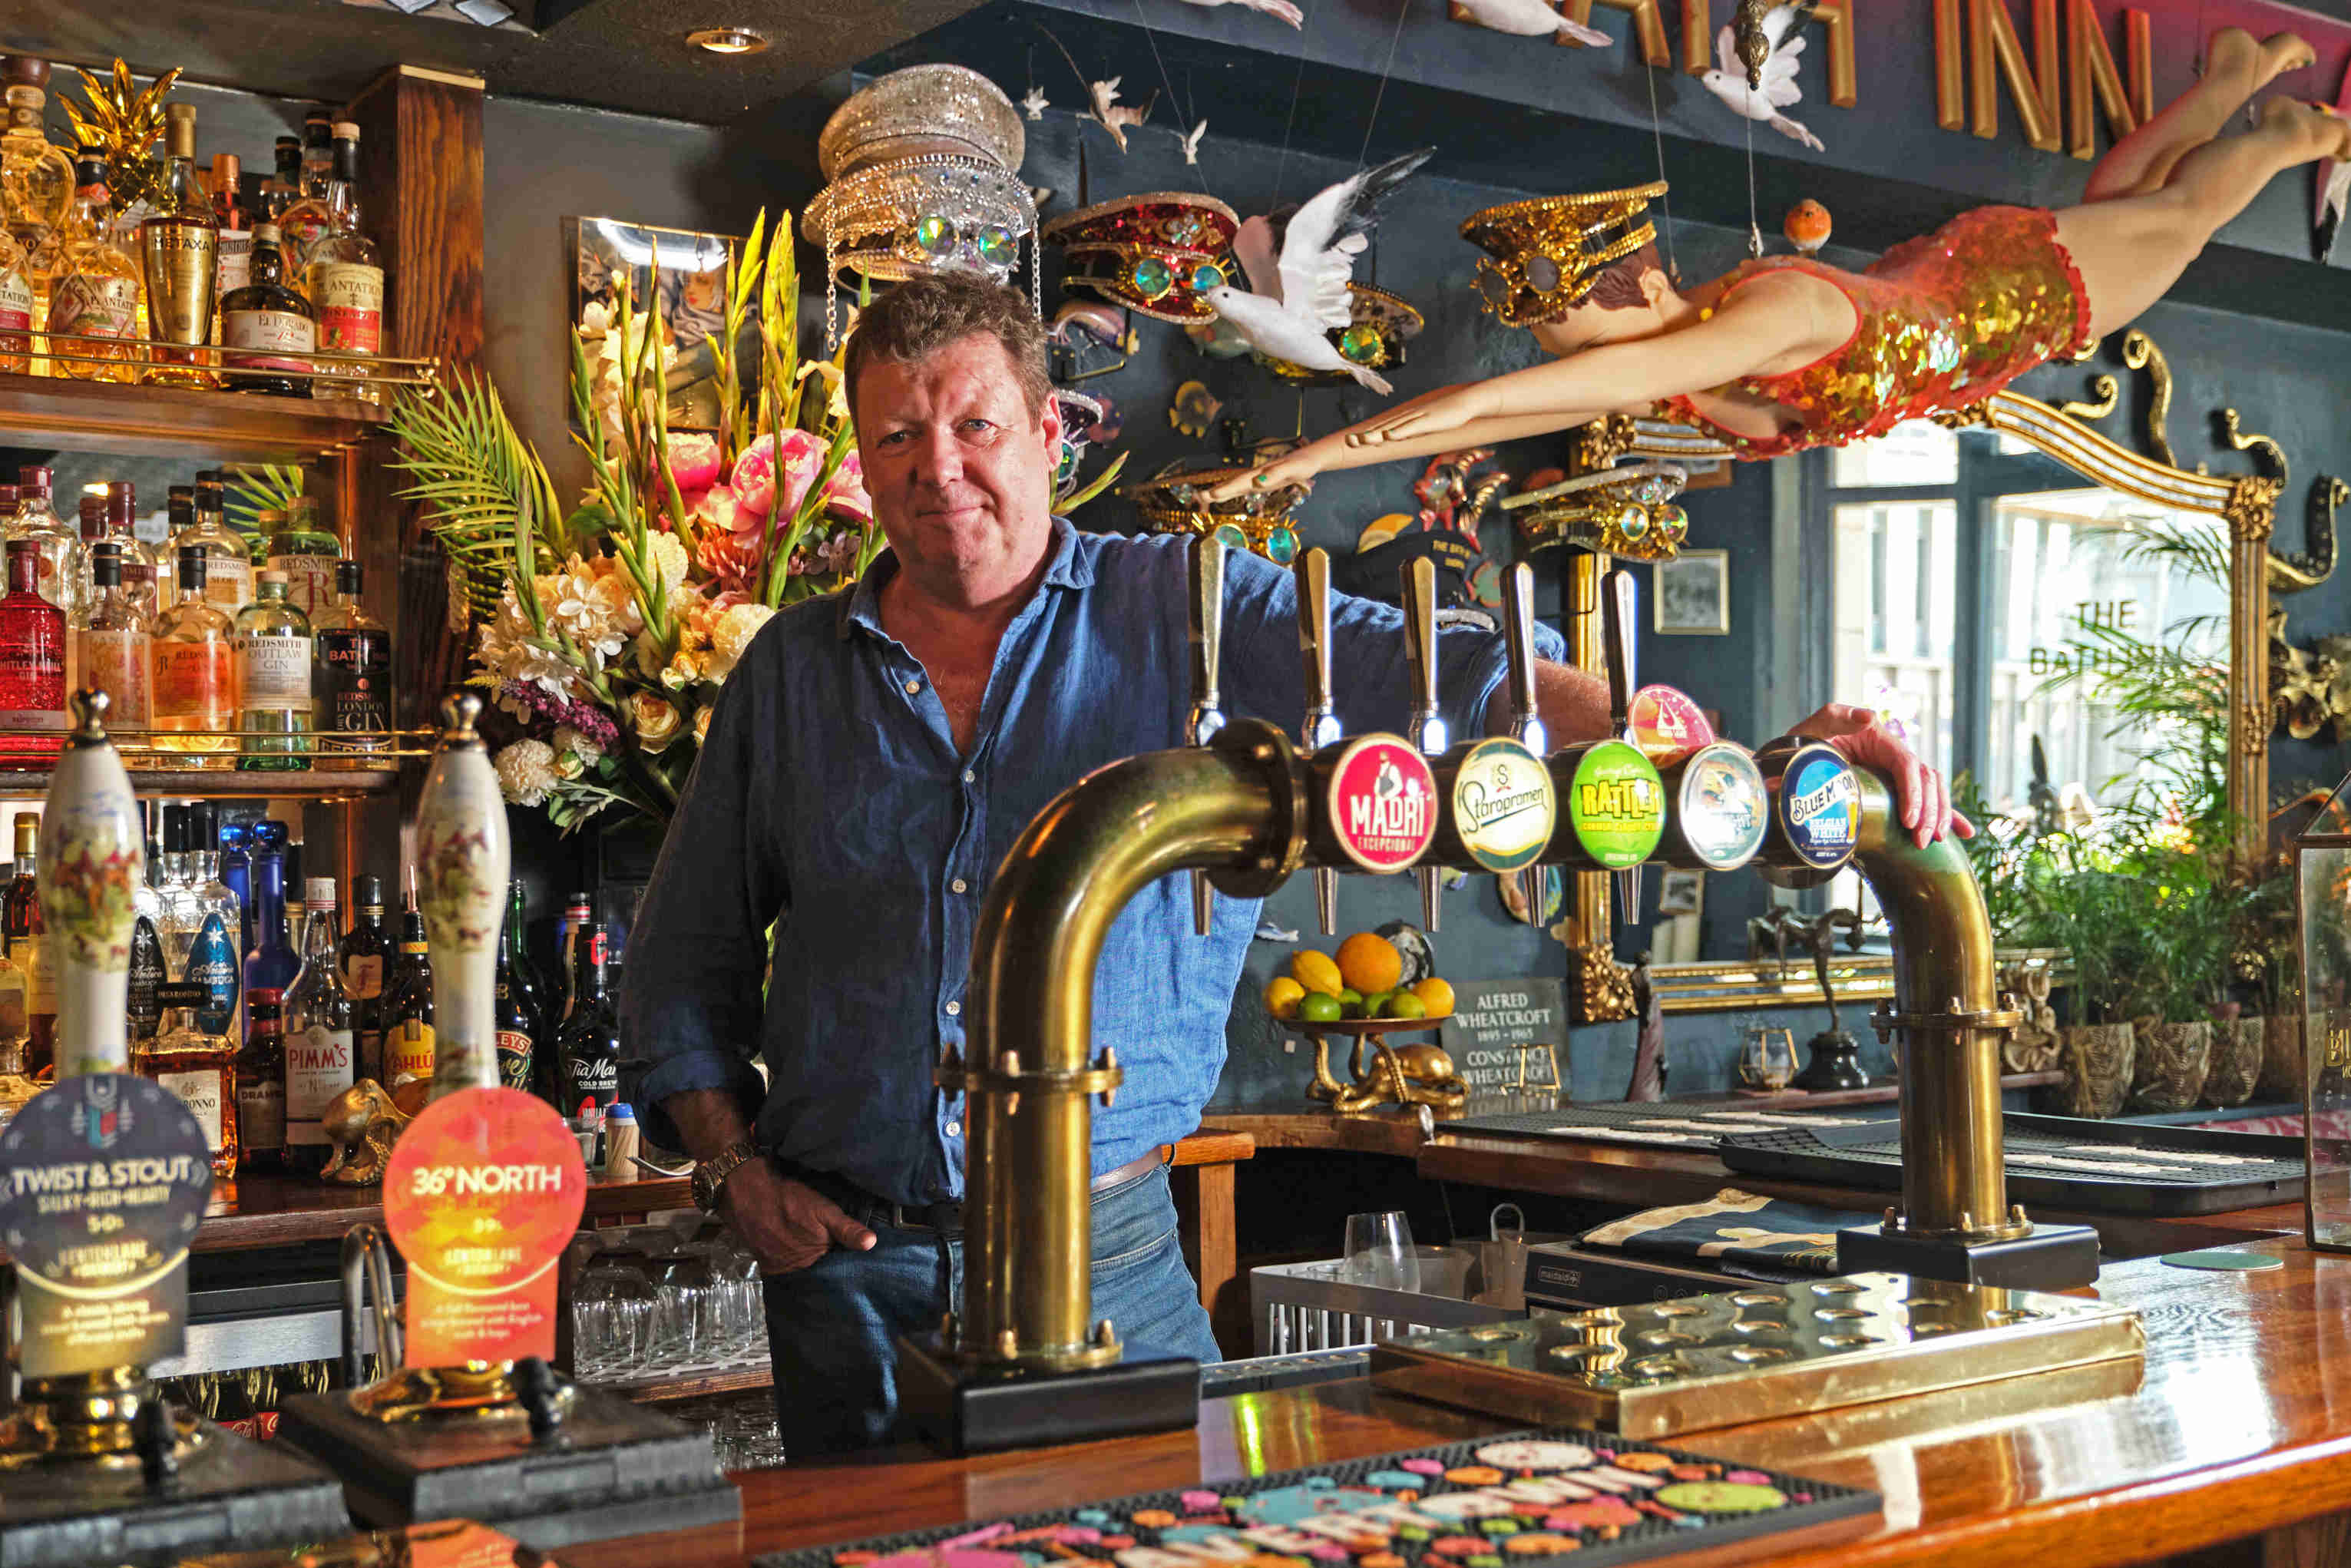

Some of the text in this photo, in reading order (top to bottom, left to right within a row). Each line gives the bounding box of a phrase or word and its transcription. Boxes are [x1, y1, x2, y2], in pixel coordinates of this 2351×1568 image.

[153, 237, 210, 252] METAXA
[2076, 600, 2137, 628] THE
[263, 660, 289, 670] GIN
[1460, 778, 1545, 835] Staropramen
[1793, 773, 1855, 822] BLUE MON
[1476, 992, 1529, 1010] ALFRED
[1454, 1008, 1552, 1029] WHEATCROFT
[289, 1044, 349, 1070] PIMM'S
[587, 1058, 617, 1080] Mar
[184, 1098, 216, 1110] RONNO
[11, 1154, 193, 1196] TWIST & STOUT
